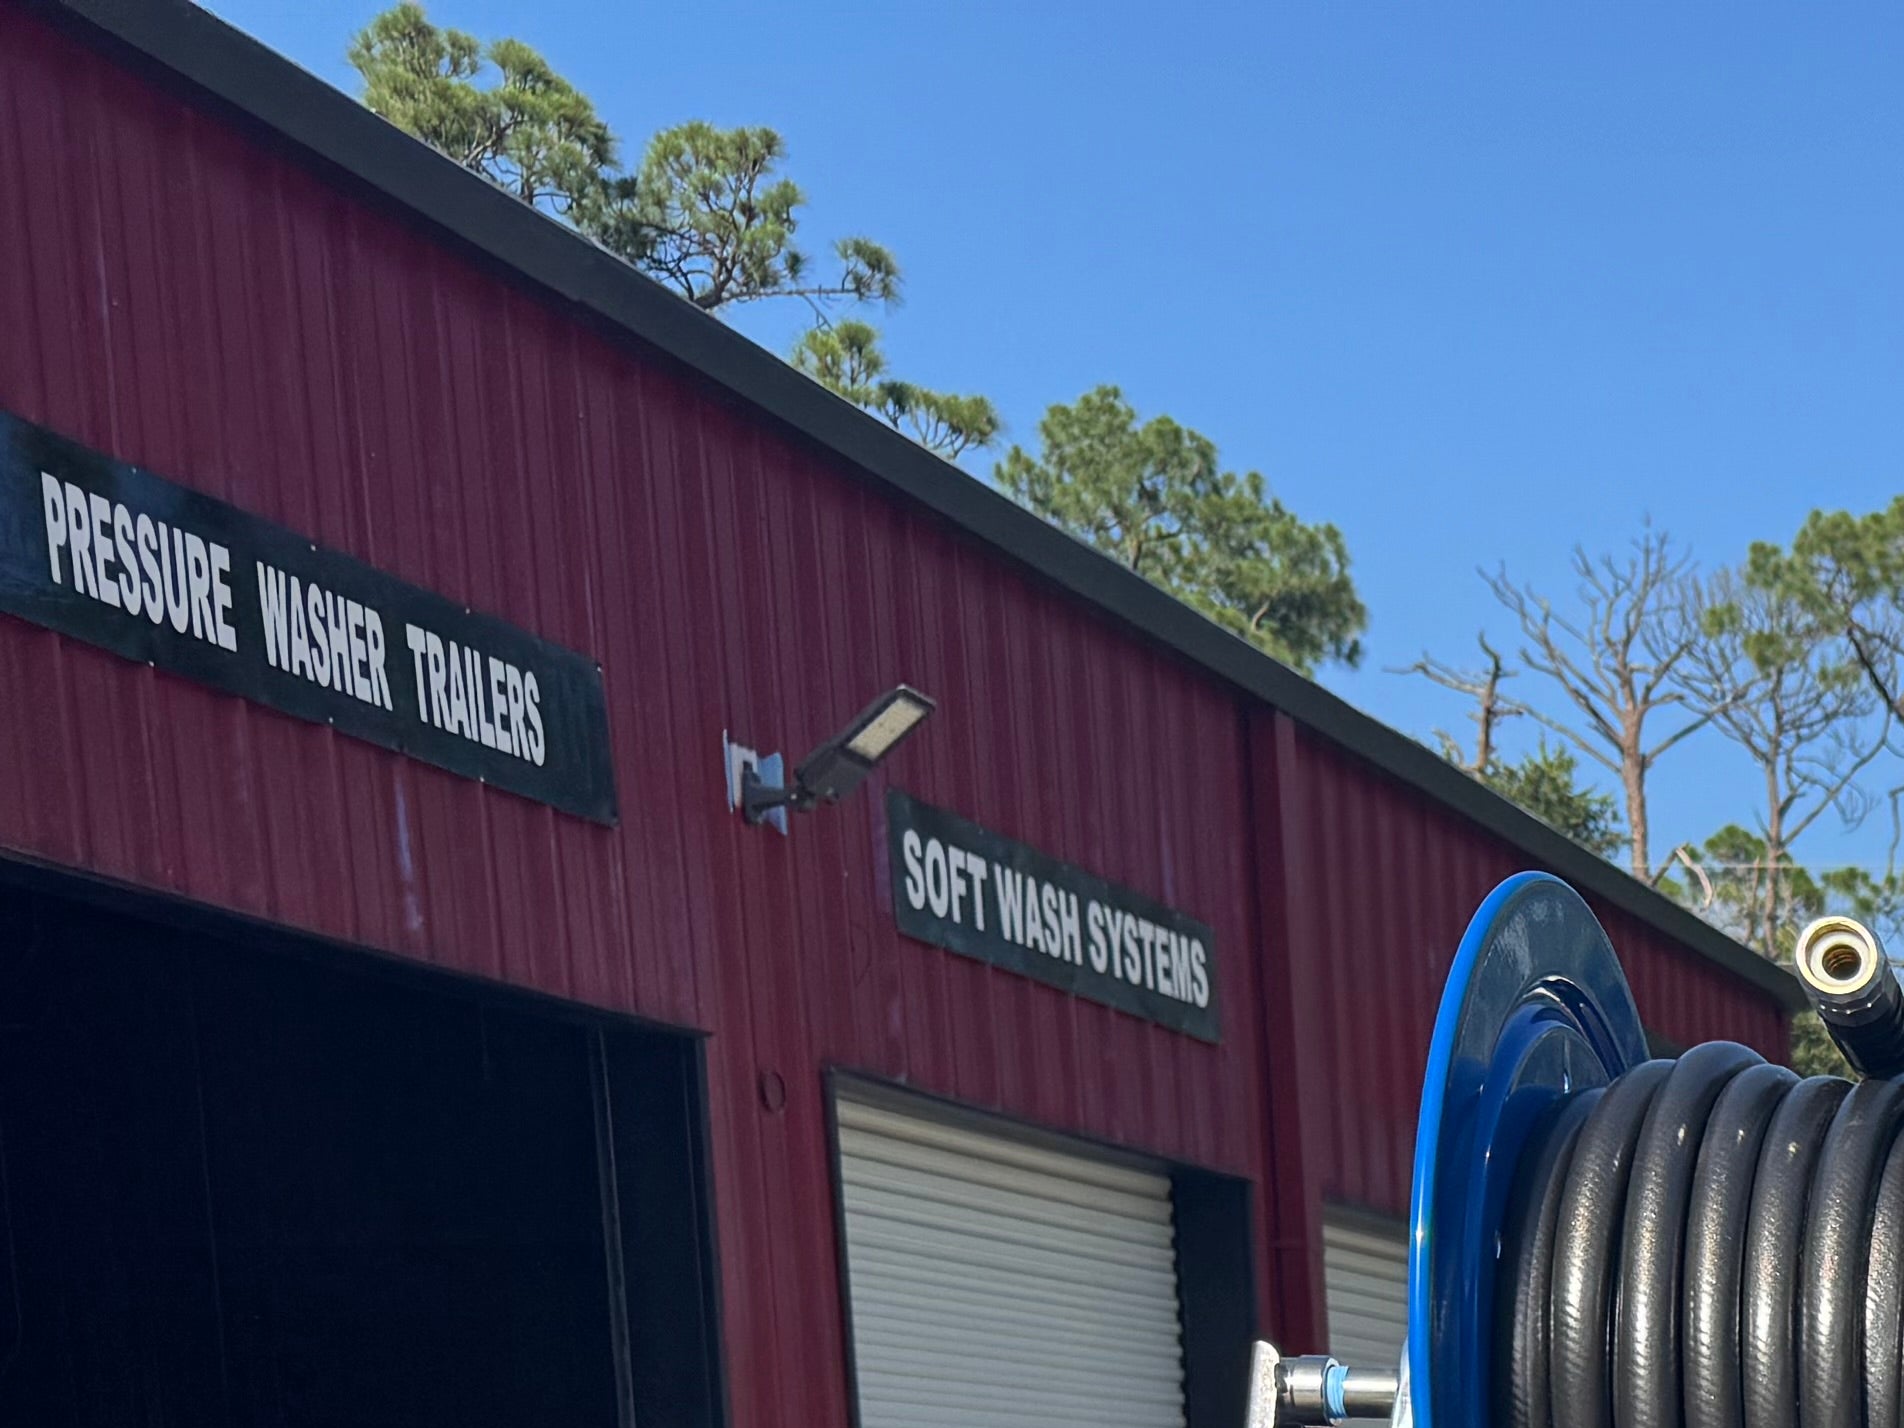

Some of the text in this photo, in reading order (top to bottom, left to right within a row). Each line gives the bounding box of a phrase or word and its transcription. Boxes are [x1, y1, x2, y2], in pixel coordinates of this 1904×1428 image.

[41, 472, 546, 767] PRESSURE WASHER TRAILERS
[903, 829, 1209, 1008] SOFT WASH SYSTEMS
